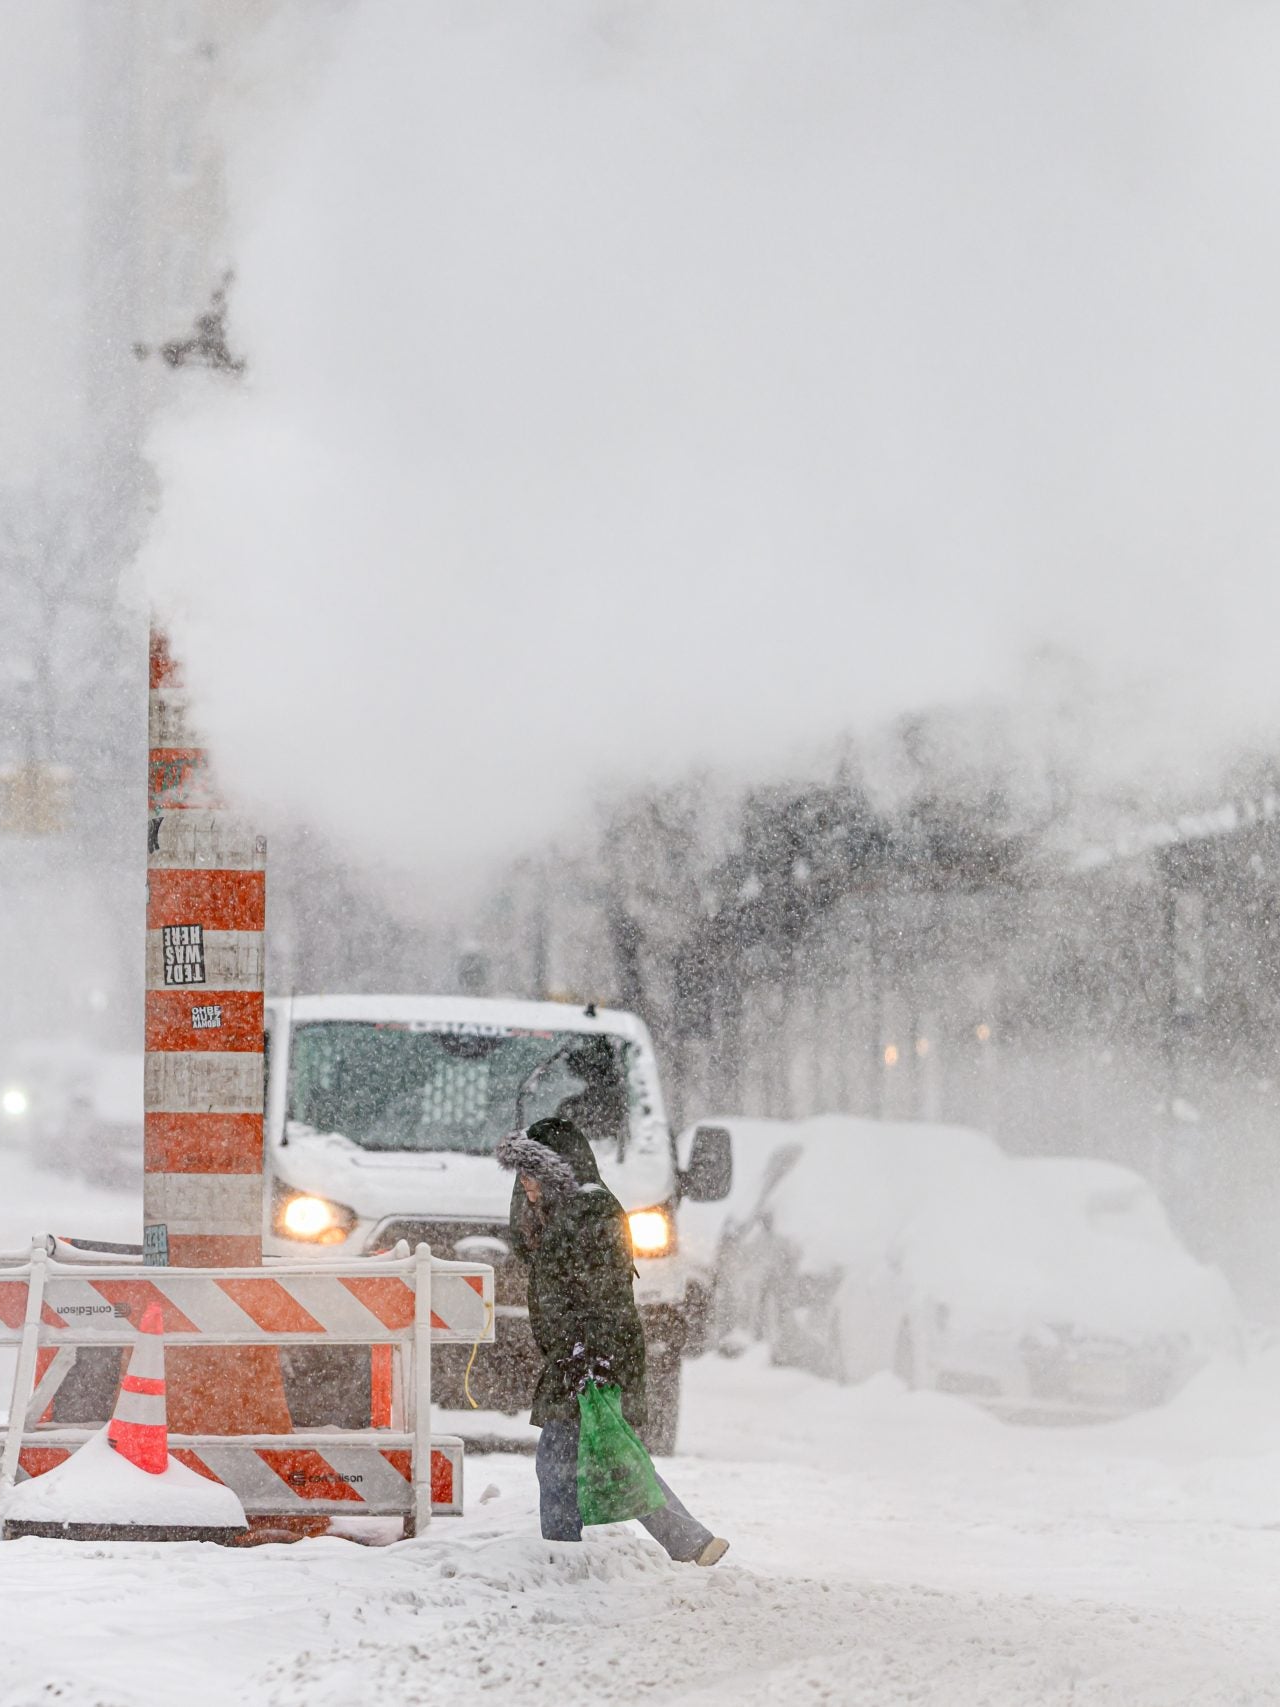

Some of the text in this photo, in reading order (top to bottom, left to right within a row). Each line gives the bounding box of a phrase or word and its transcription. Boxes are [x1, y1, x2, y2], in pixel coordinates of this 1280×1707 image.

[164, 926, 201, 946] HERE
[165, 945, 202, 965] WAS
[165, 963, 203, 983] TEDZ
[56, 1304, 112, 1316] conEdison
